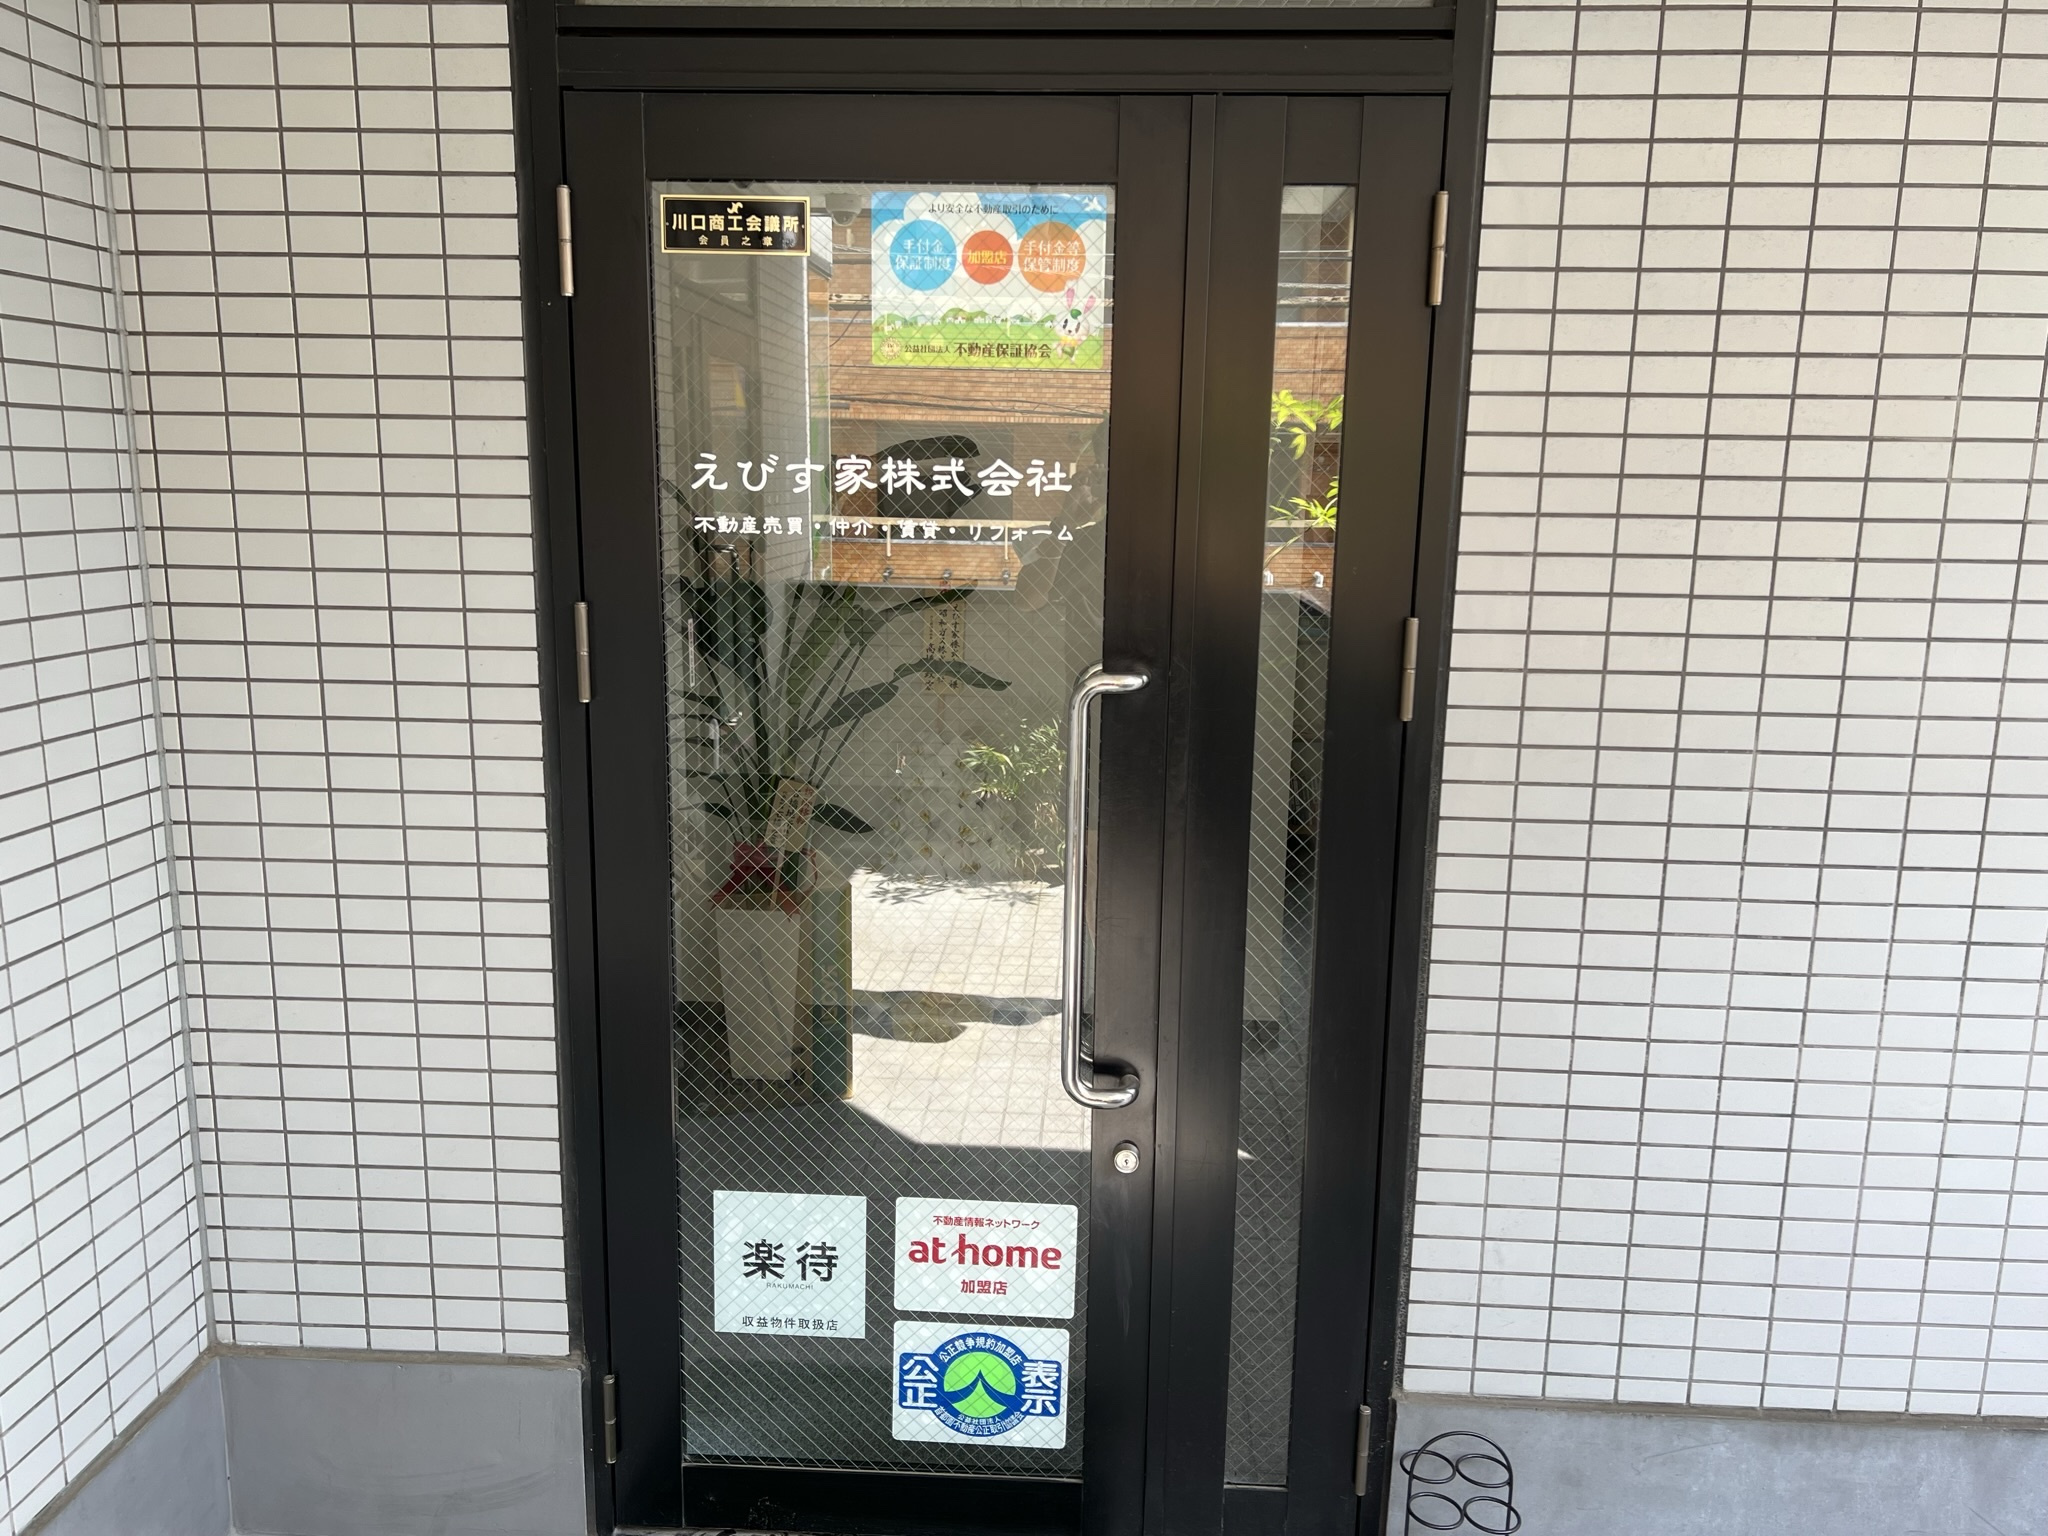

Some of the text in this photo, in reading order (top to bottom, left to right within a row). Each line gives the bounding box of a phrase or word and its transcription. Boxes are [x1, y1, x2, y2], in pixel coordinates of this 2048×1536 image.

[928, 203, 1058, 214] より安全な不動産取引のために
[671, 213, 799, 233] 川口商工会議所
[698, 234, 773, 247] 会員之章
[903, 239, 944, 254] 手付金
[1023, 241, 1081, 256] 手付金等
[895, 254, 952, 271] 保証制度
[967, 249, 1007, 265] 加盟店
[1023, 257, 1081, 273] 保管制度
[904, 342, 1052, 359] 公益社団法人 不動産保証協会
[690, 452, 1073, 498] えびす家株式会社
[693, 515, 1074, 542] 不動産売買・仲介・賃貸・リフォーム
[933, 1215, 1041, 1230] 不動産情報ネットワーク
[908, 1233, 1063, 1269] at home
[741, 1238, 839, 1282] 楽待
[766, 1281, 814, 1290] RAKUMACHI
[960, 1279, 1008, 1296] 加盟店
[741, 1315, 838, 1332] 収益物件取扱店
[938, 1336, 1023, 1367] 公正競争規約加盟店
[902, 1355, 939, 1409] 公正
[1021, 1359, 1060, 1416] 表示
